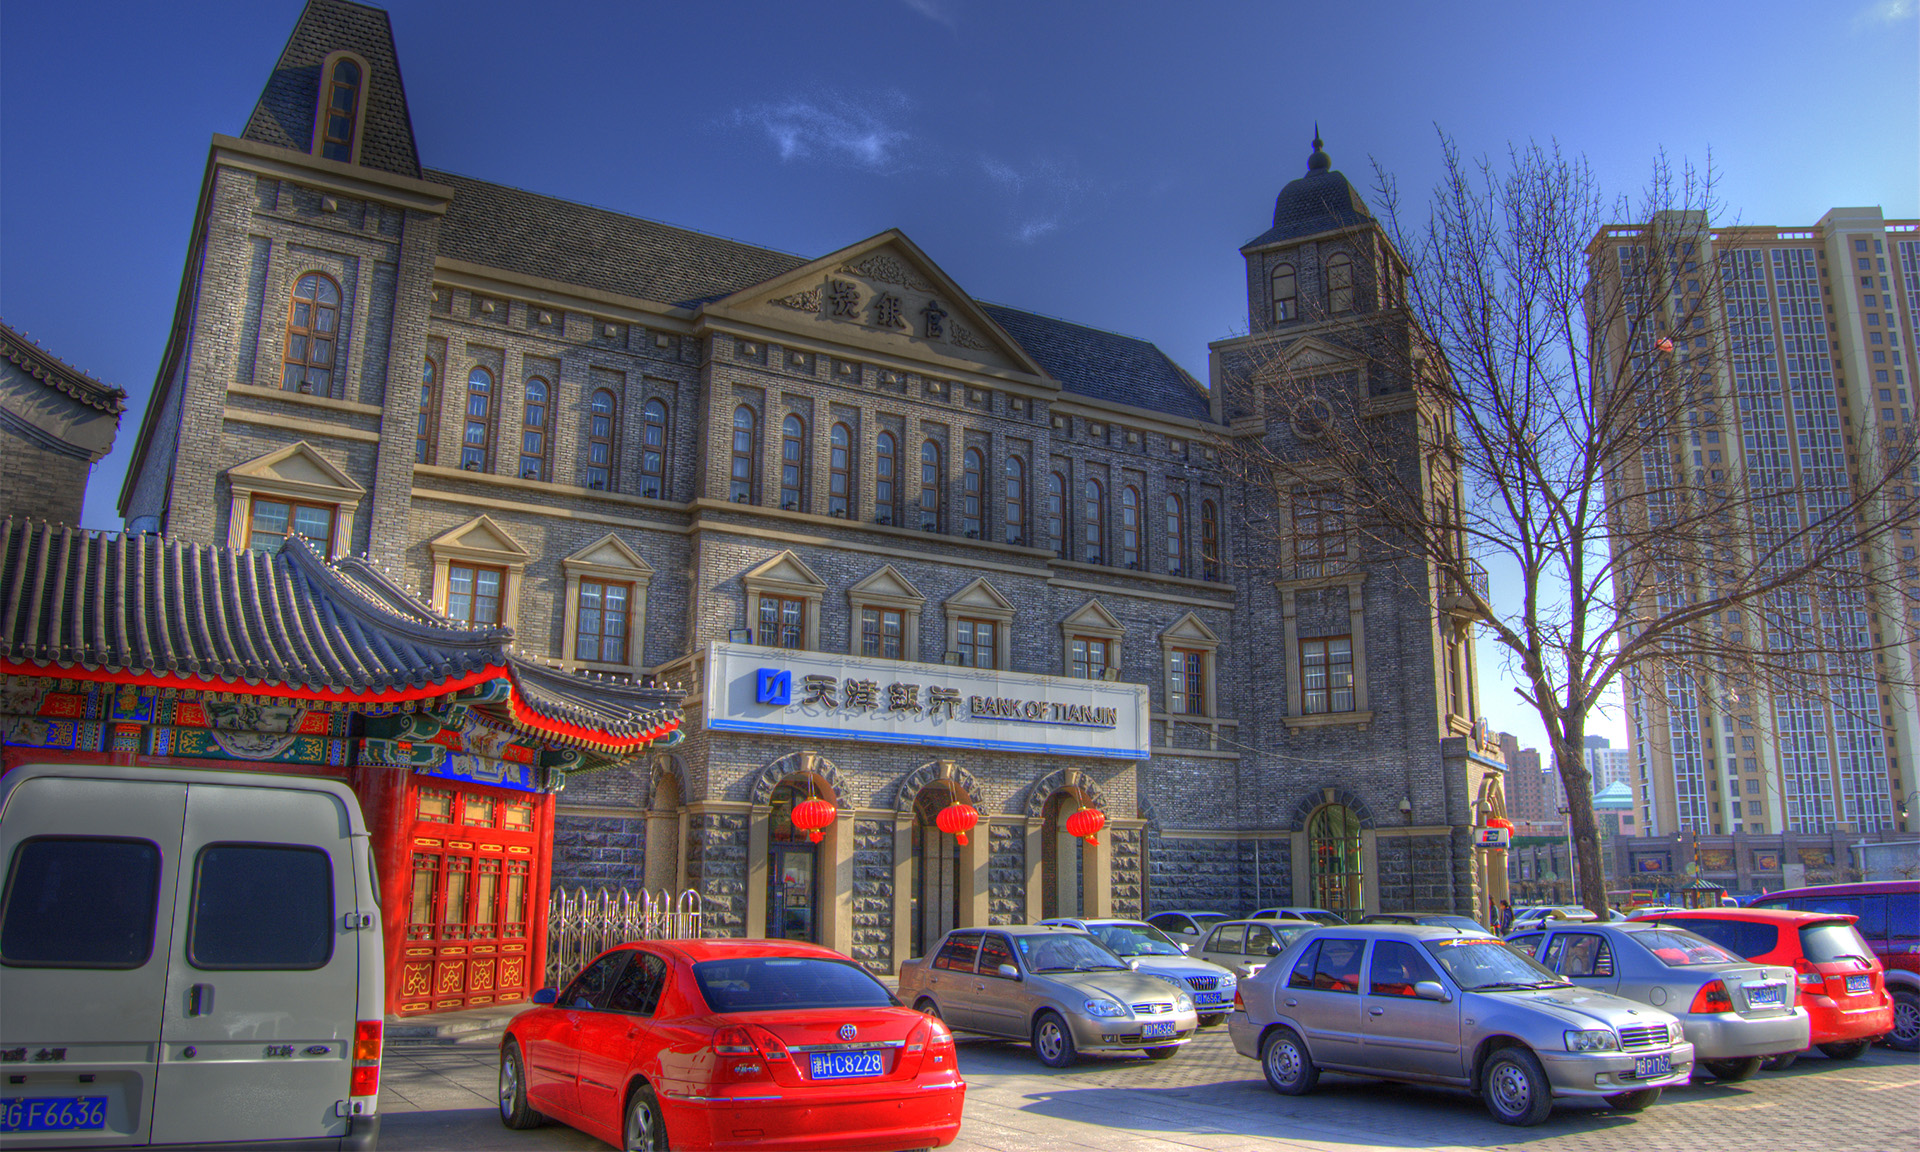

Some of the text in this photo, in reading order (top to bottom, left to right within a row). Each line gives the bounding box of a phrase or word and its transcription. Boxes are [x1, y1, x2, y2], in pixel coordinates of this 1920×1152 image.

[971, 695, 1117, 725] BANK OF TIANJIN
